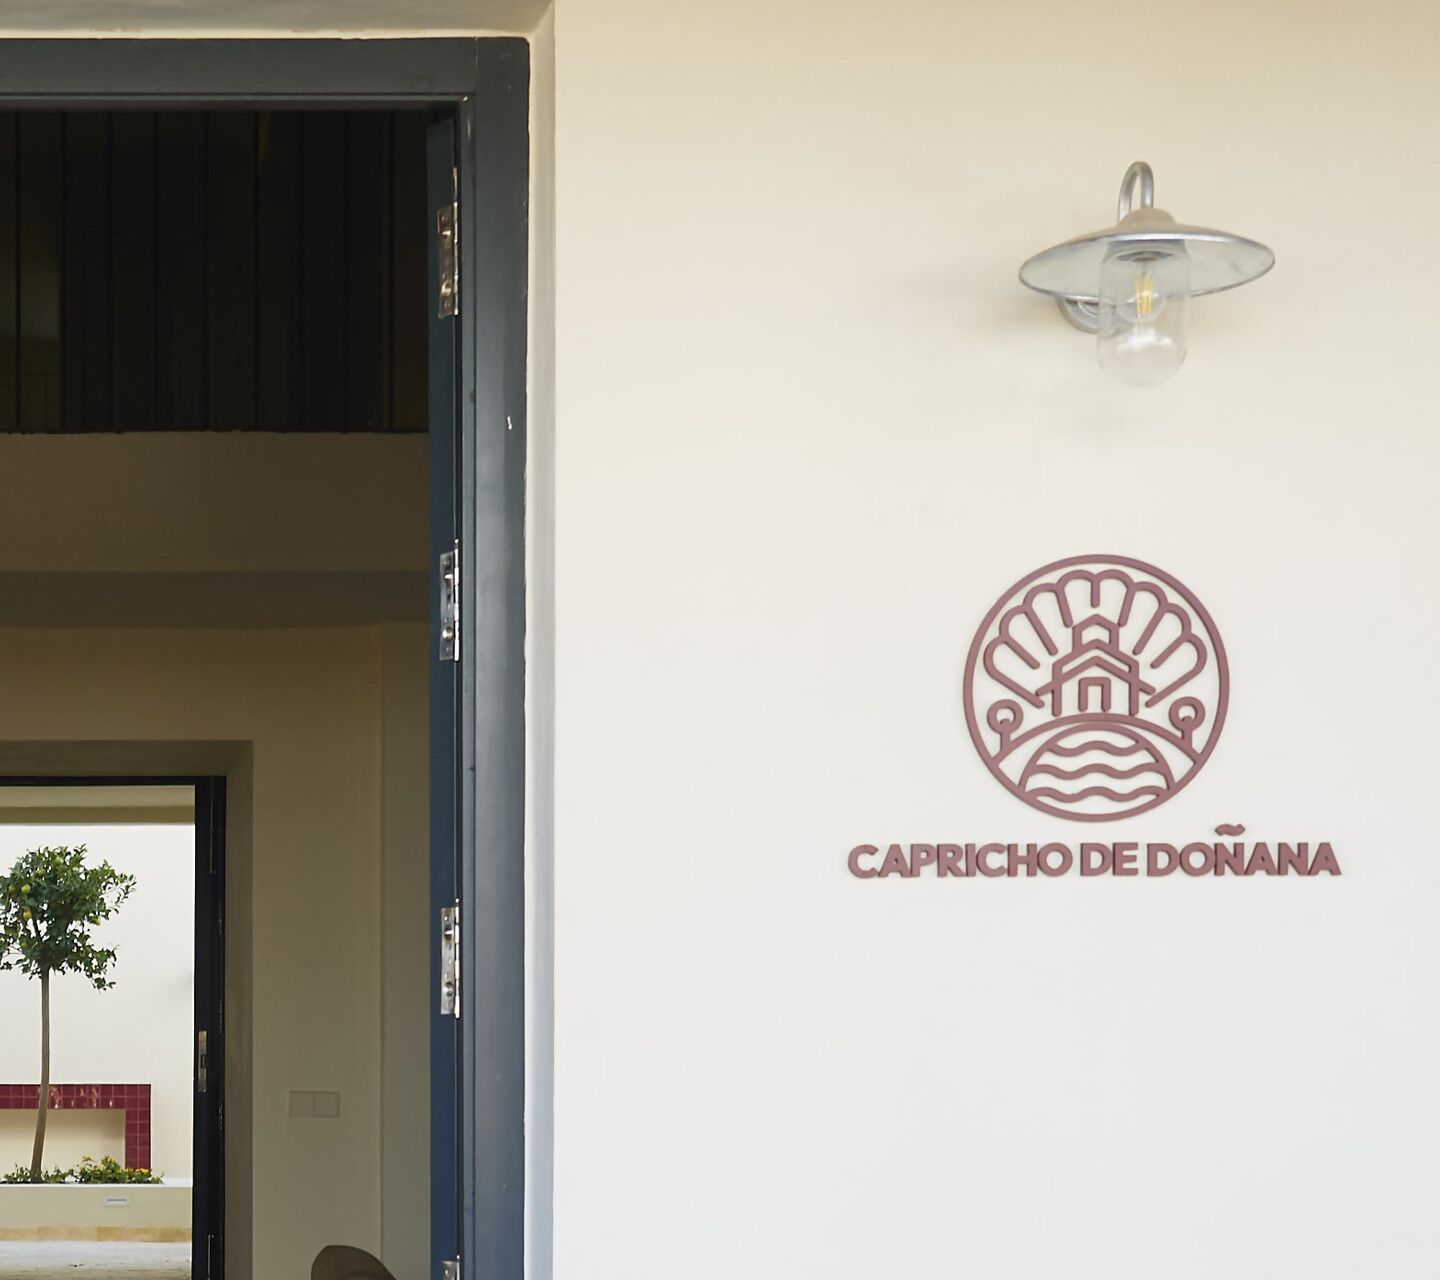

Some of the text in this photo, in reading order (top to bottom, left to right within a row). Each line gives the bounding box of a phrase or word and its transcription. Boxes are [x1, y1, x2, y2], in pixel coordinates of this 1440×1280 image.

[847, 823, 1342, 878] CAPRICHO DE DOÑANA
